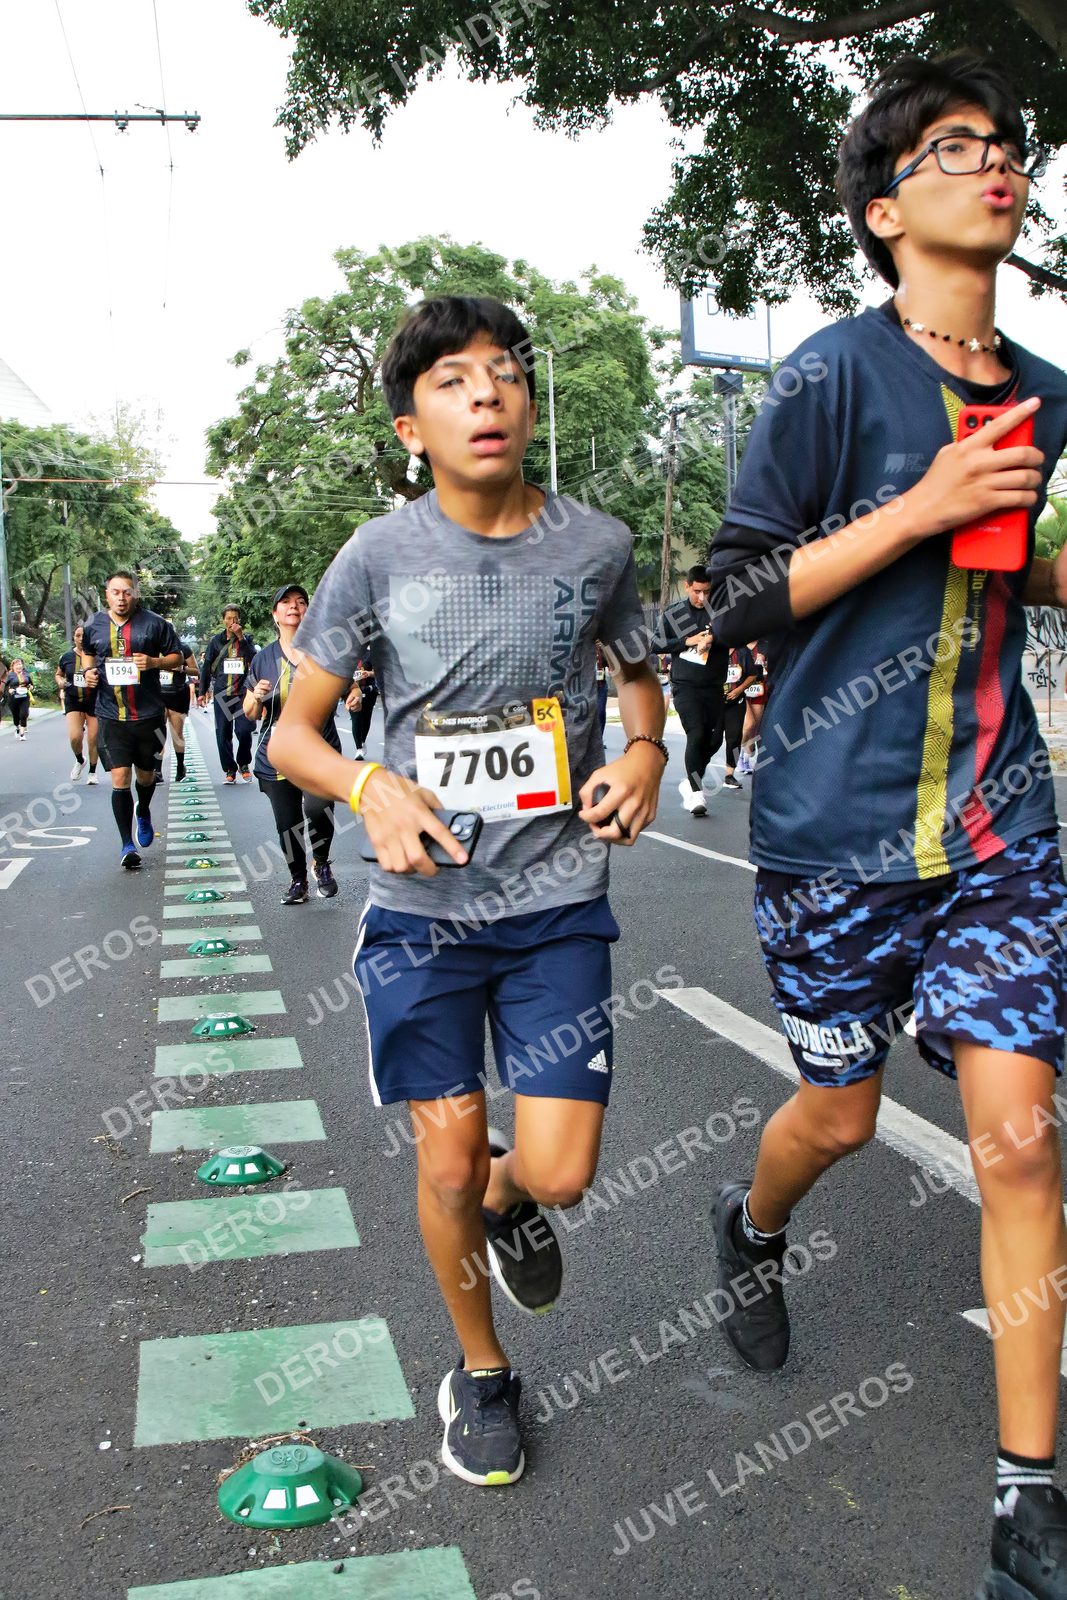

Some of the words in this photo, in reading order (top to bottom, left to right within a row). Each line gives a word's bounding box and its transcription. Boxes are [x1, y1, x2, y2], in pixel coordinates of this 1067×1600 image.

[110, 666, 133, 676] 1594
[547, 576, 576, 737] ARMO
[434, 741, 535, 787] 7706
